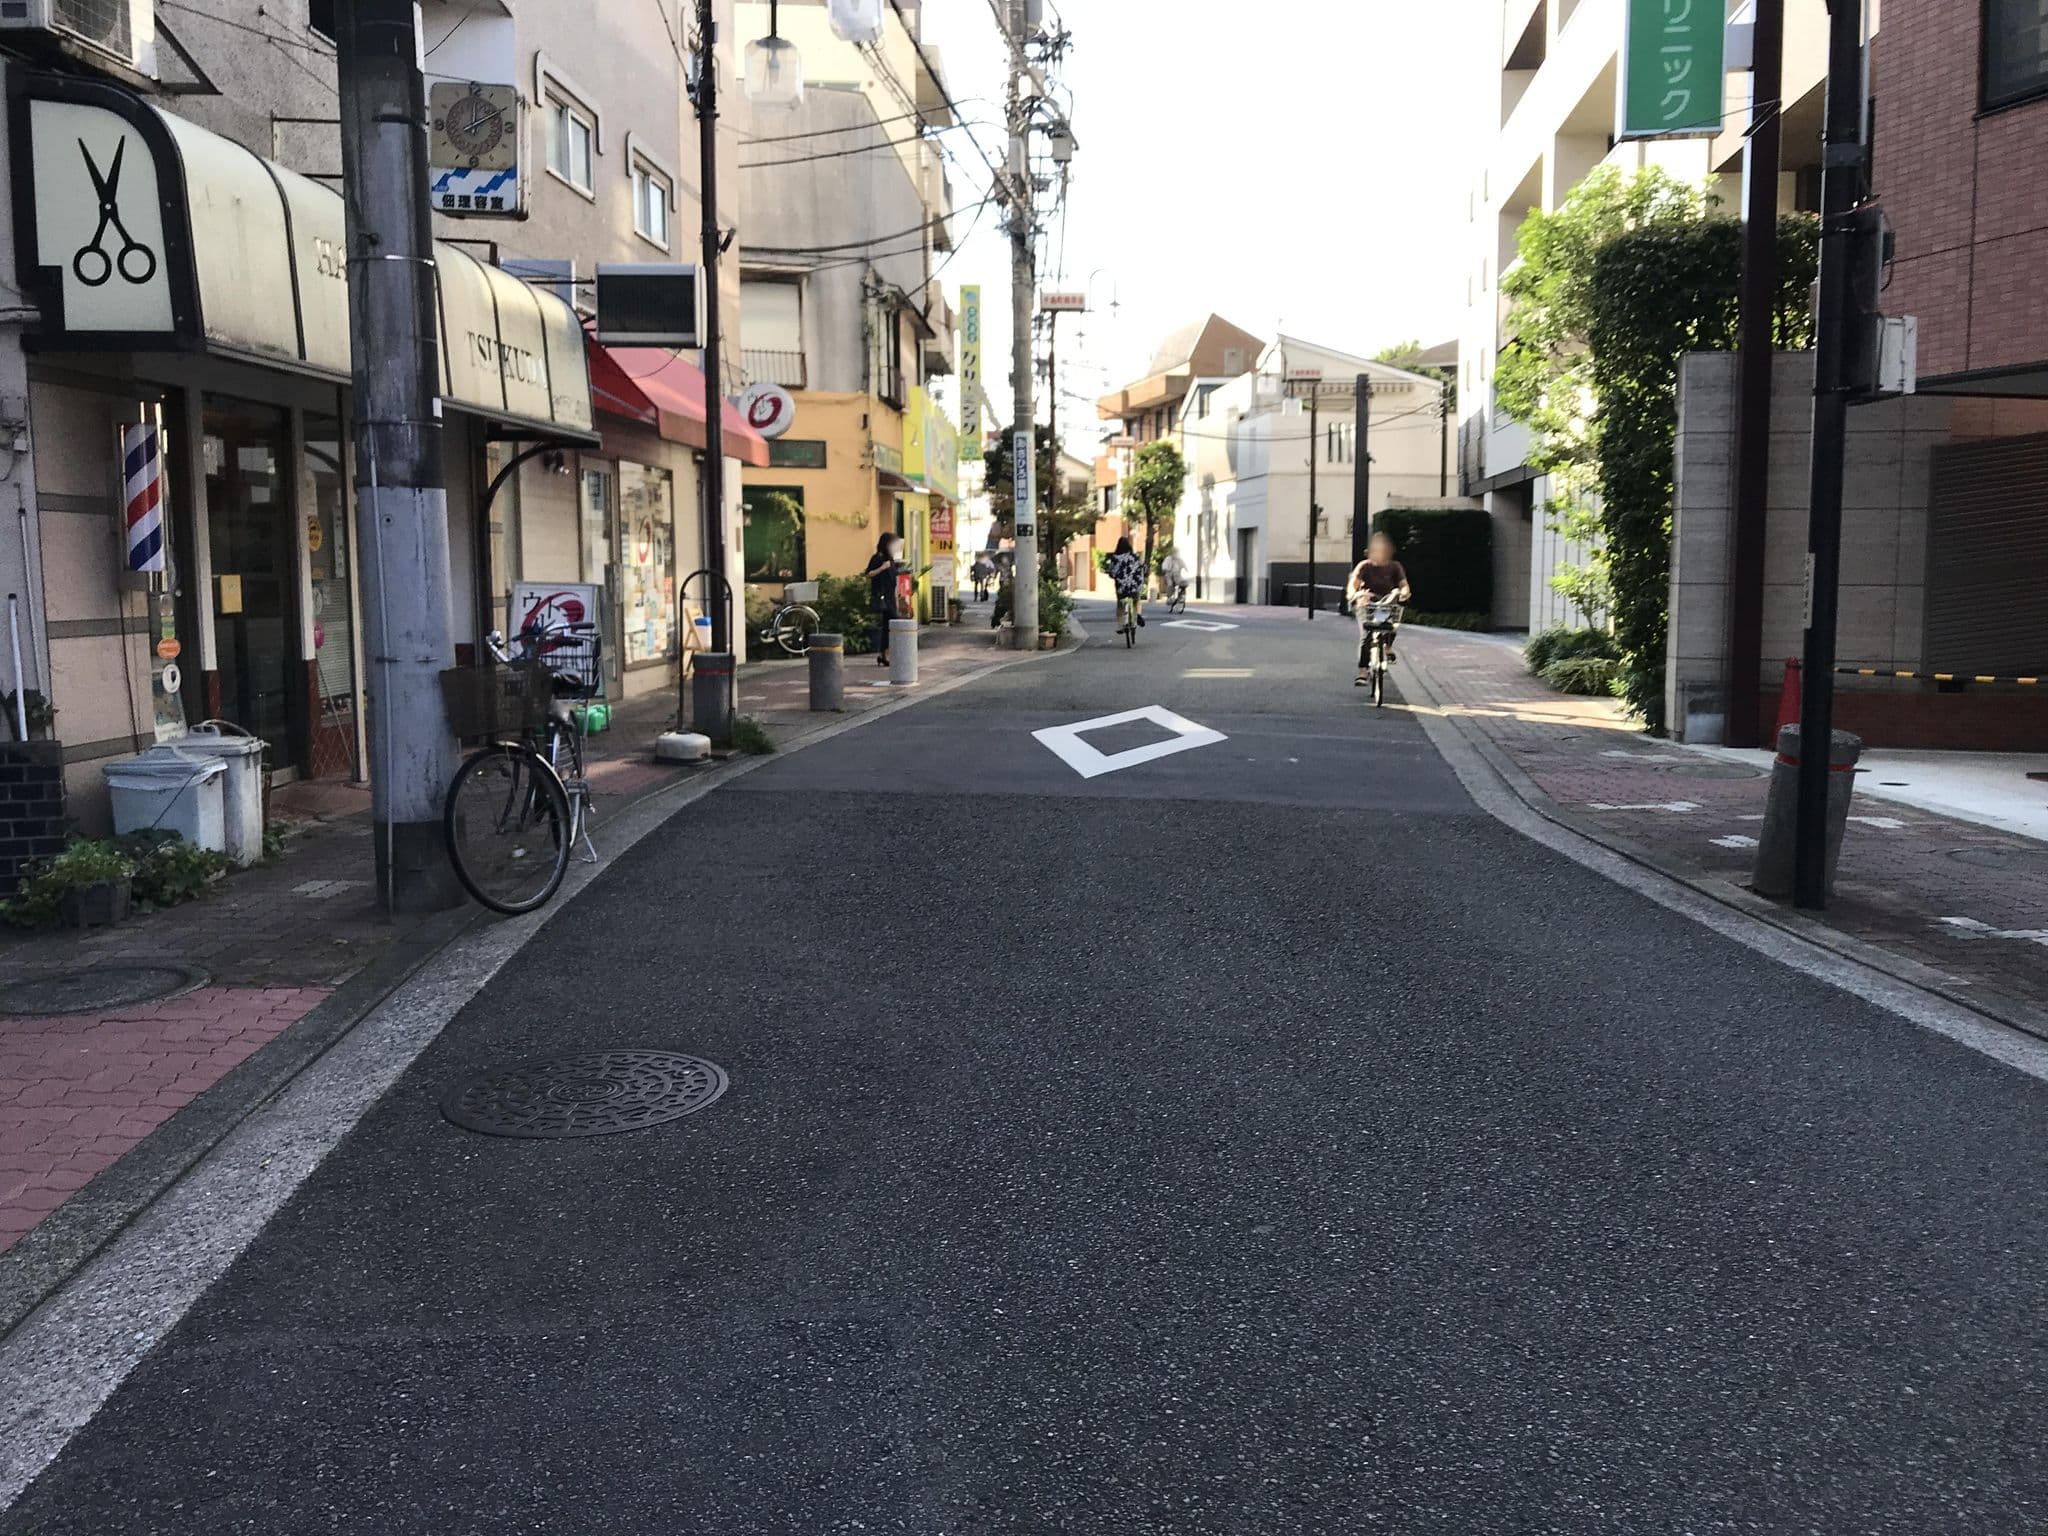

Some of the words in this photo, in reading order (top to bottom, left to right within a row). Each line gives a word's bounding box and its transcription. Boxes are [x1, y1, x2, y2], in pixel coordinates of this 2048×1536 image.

[504, 121, 514, 134] 3
[466, 330, 549, 389] TSUKUDA
[963, 351, 977, 436] クリーニング
[931, 508, 951, 522] 24
